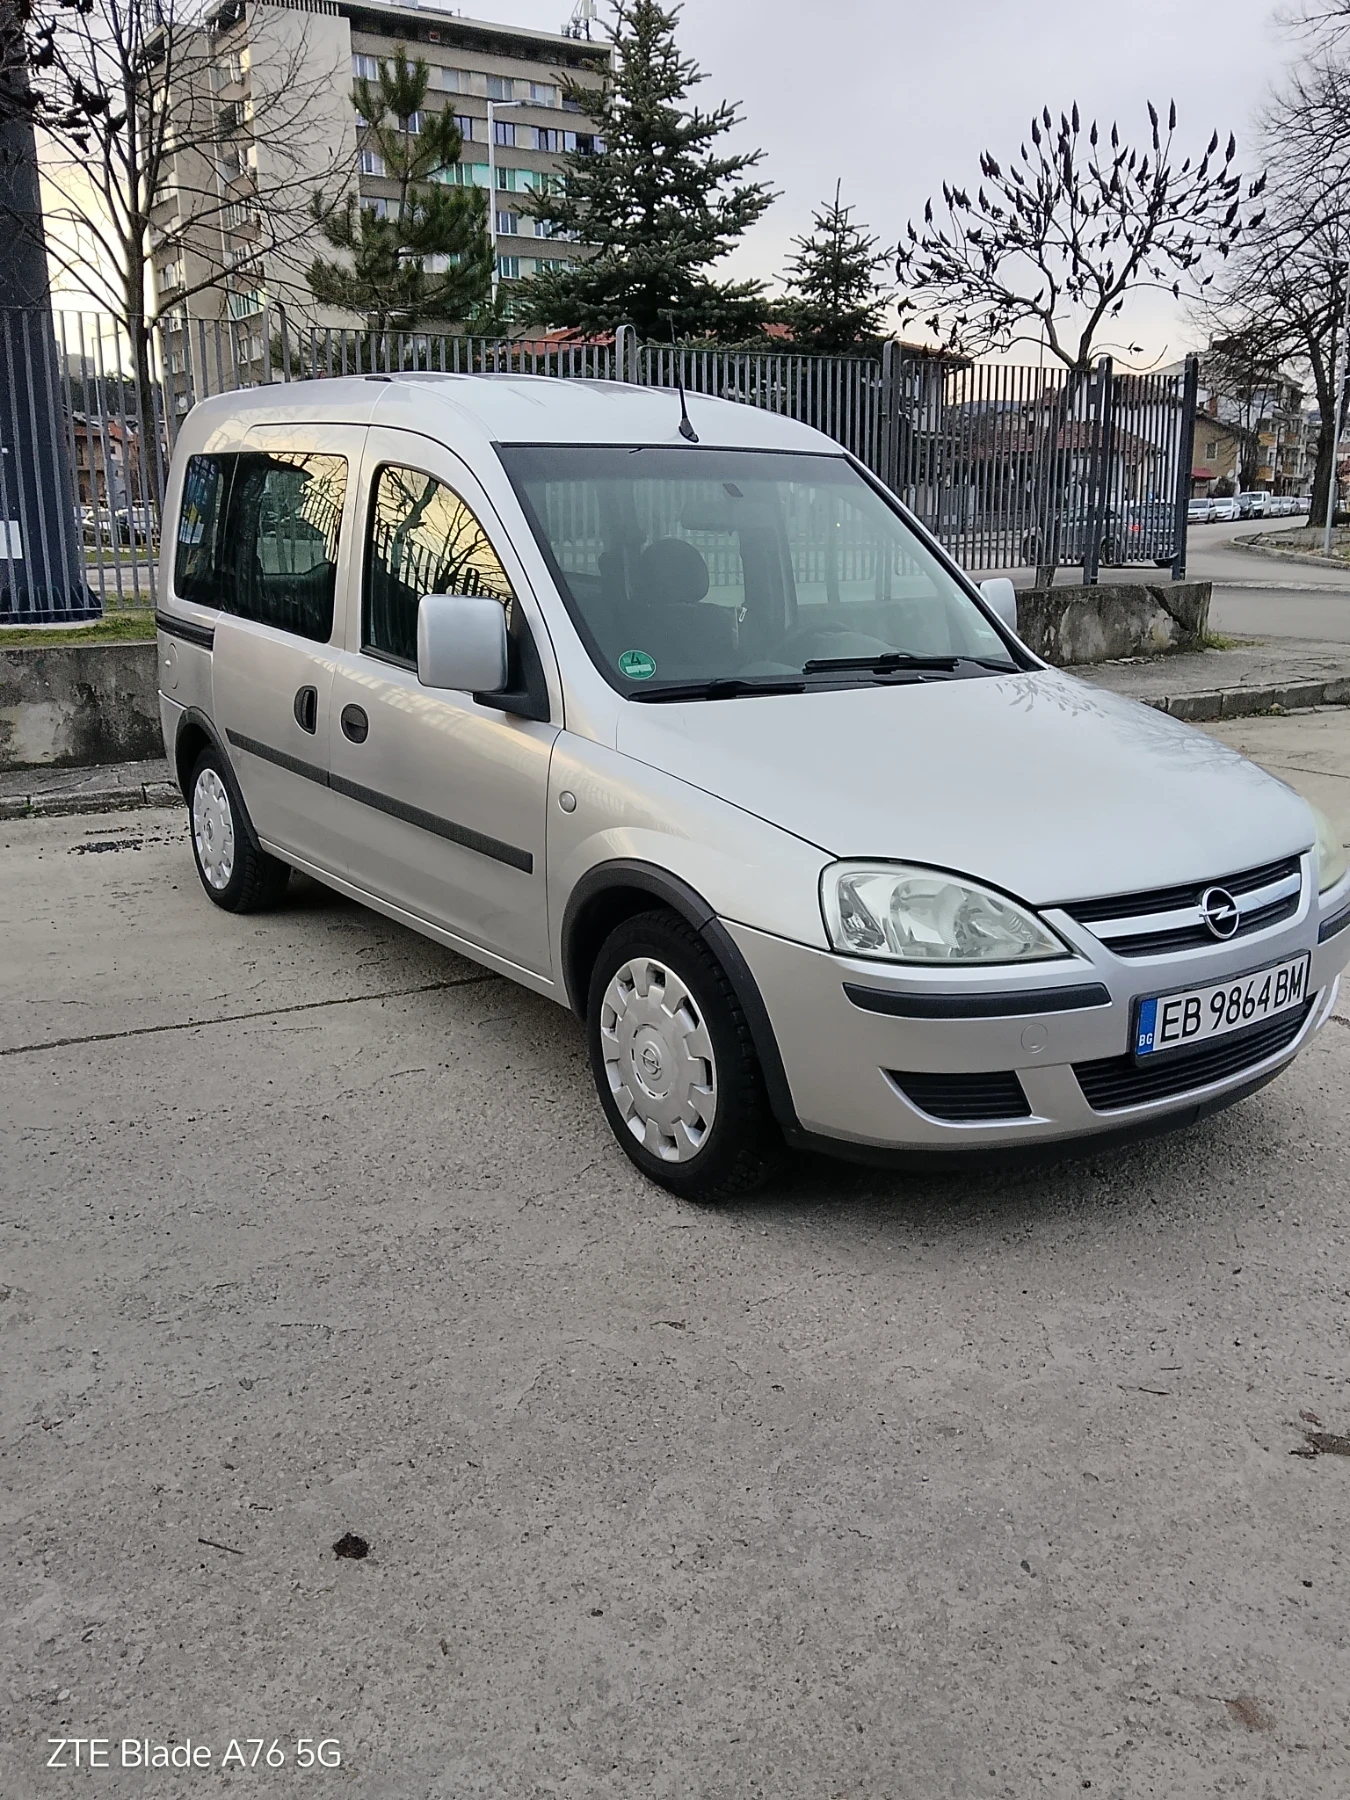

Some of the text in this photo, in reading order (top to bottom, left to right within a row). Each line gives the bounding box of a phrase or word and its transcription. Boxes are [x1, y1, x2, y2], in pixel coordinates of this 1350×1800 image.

[1160, 962, 1304, 1043] EB 9864 BM
[1139, 1033, 1153, 1047] BG
